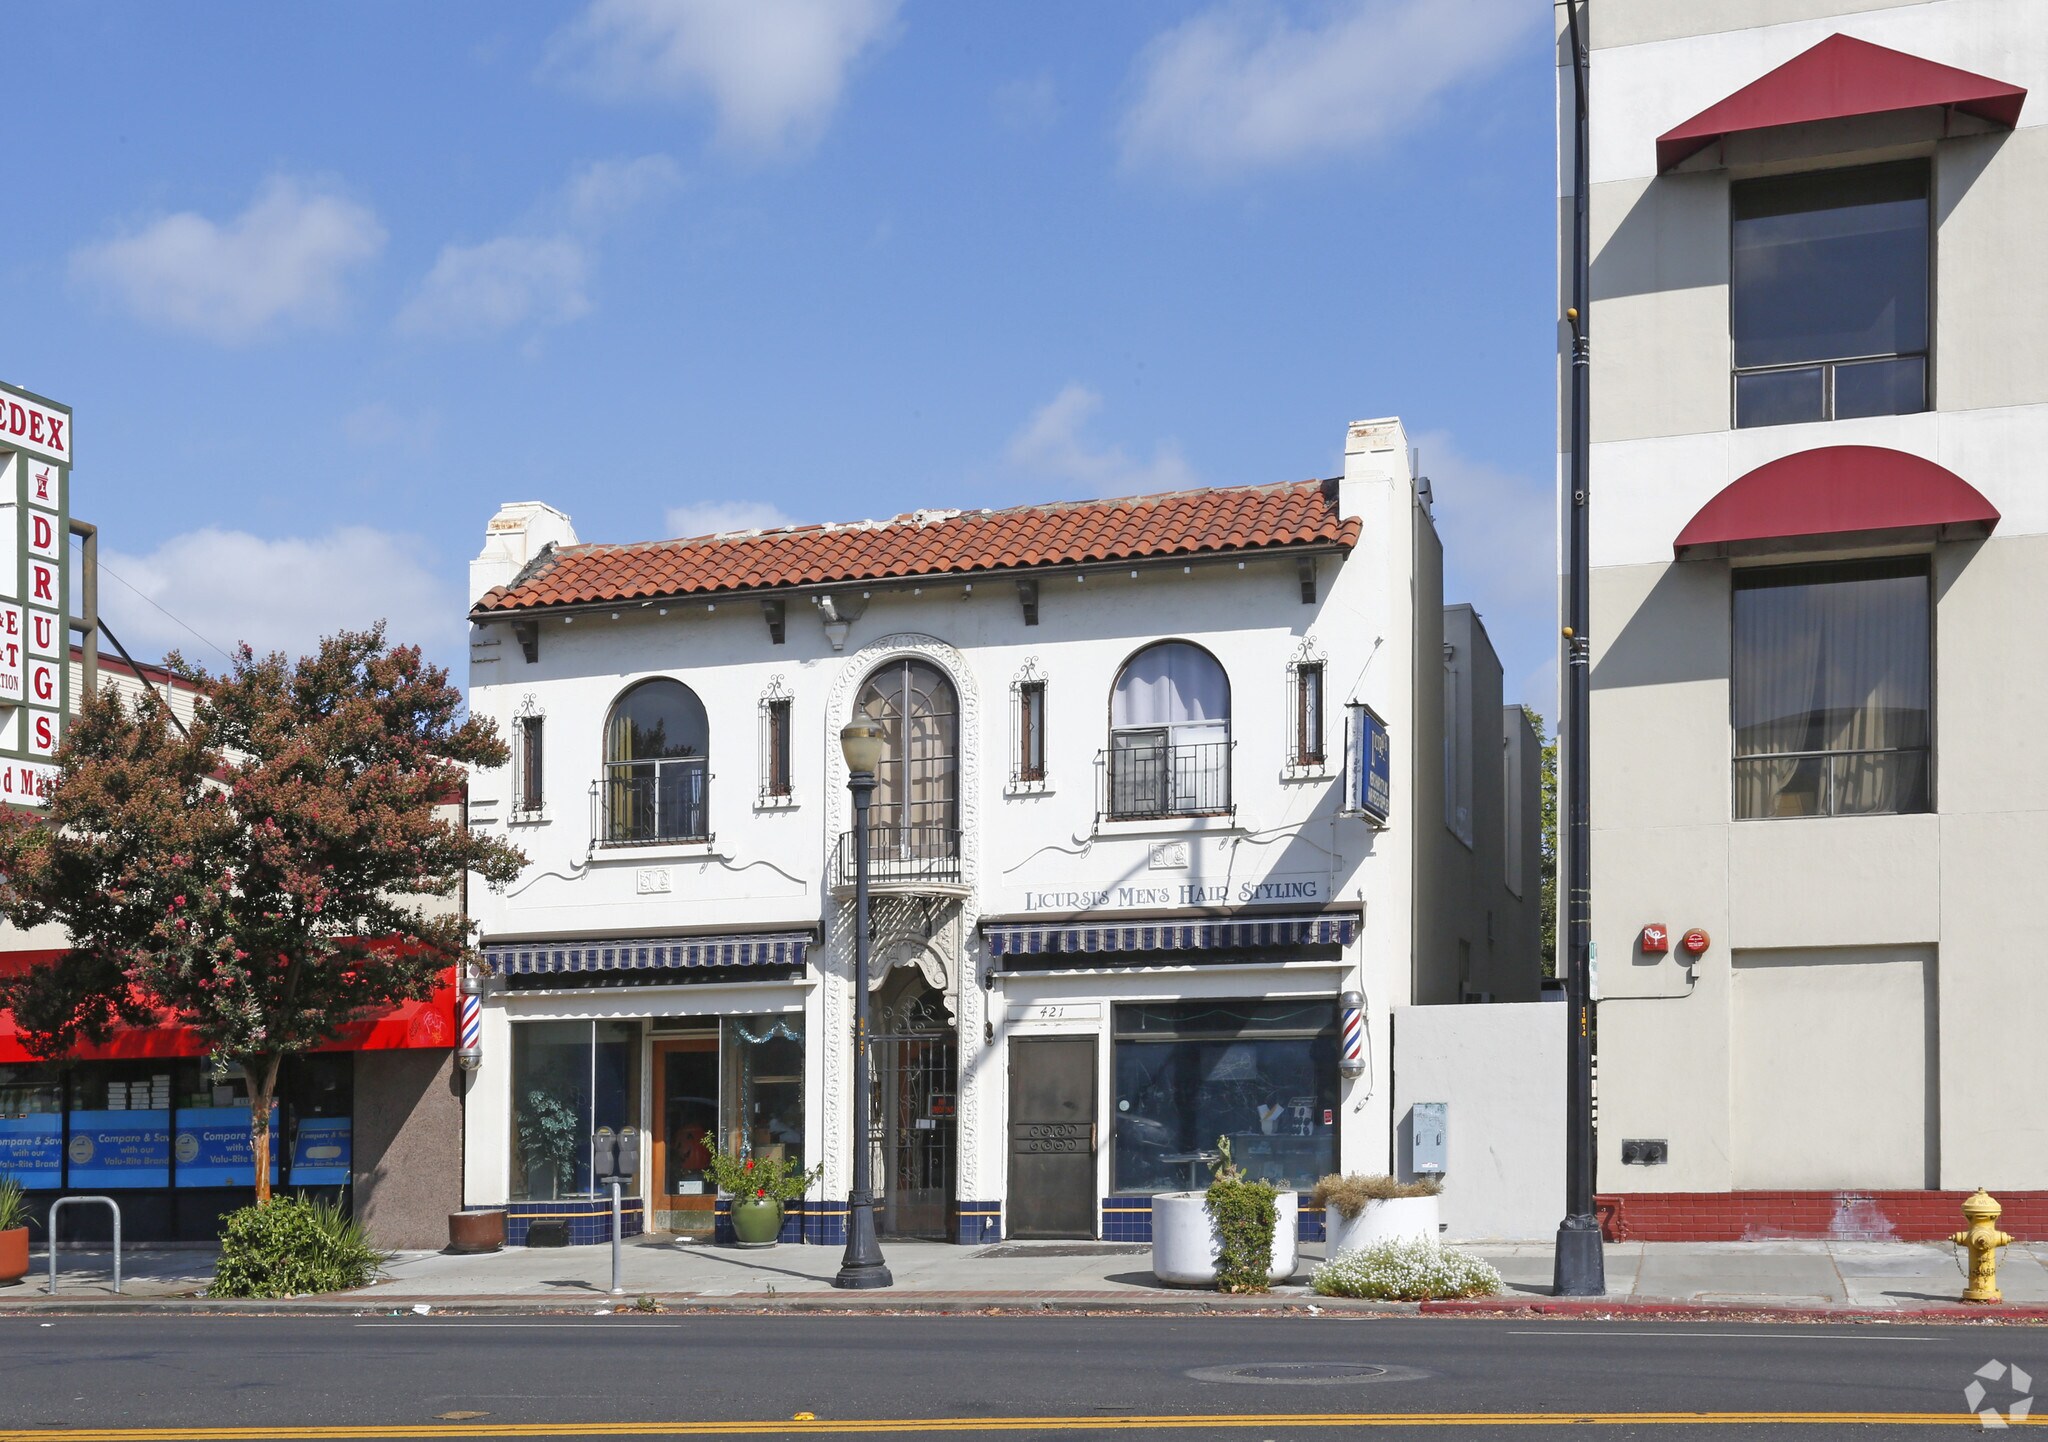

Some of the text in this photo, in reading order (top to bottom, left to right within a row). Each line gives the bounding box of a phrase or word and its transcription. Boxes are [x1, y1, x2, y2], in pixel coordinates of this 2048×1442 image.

[33, 515, 54, 751] DRUGS
[0, 673, 19, 691] TION
[1178, 884, 1230, 905] HAIR
[1238, 881, 1317, 902] STYLING
[1040, 1006, 1064, 1018] 421
[34, 1136, 41, 1146] &
[44, 1136, 62, 1145] Sav
[98, 1133, 169, 1144] Compare & Sav
[203, 1132, 246, 1141] Compare
[120, 1145, 138, 1154] with
[225, 1143, 244, 1151] with
[12, 1149, 29, 1157] with
[104, 1157, 142, 1165] Valu-Rite
[210, 1154, 248, 1163] Valu-Rite
[35, 1160, 59, 1168] Brand
